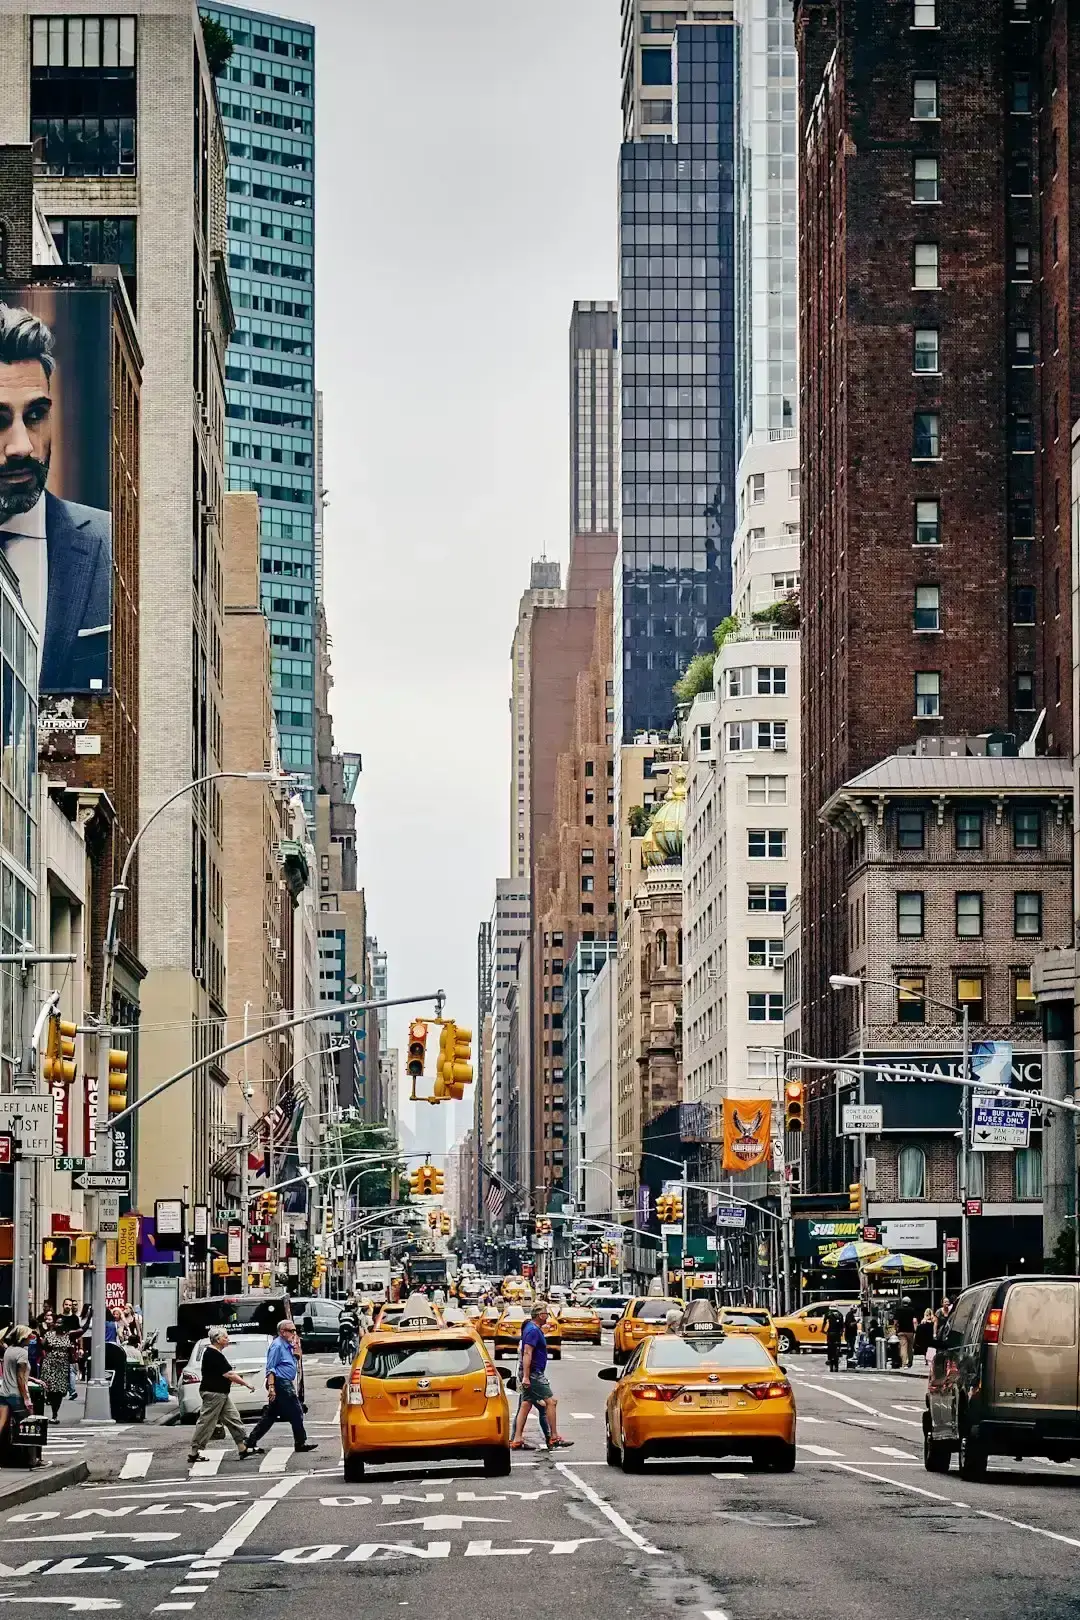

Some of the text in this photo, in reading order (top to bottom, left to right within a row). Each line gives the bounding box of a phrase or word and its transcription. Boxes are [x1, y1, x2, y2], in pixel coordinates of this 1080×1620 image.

[38, 720, 85, 728] UTFRONT
[331, 1035, 350, 1046] 575
[0, 1103, 49, 1113] EFT LANE
[1006, 1110, 1025, 1118] LANE
[977, 1115, 1025, 1125] BUSES ONLY
[27, 1139, 48, 1148] LEFT
[55, 1161, 60, 1169] E
[63, 1158, 74, 1170] 58
[80, 1176, 123, 1185] ONE WAY
[811, 1222, 859, 1235] SUBWAY
[106, 1290, 125, 1299] EMY
[319, 1490, 558, 1506] ONLY
[6, 1501, 245, 1522] ONLY
[268, 1538, 604, 1563] ONLY
[0, 1554, 205, 1577] NLY
